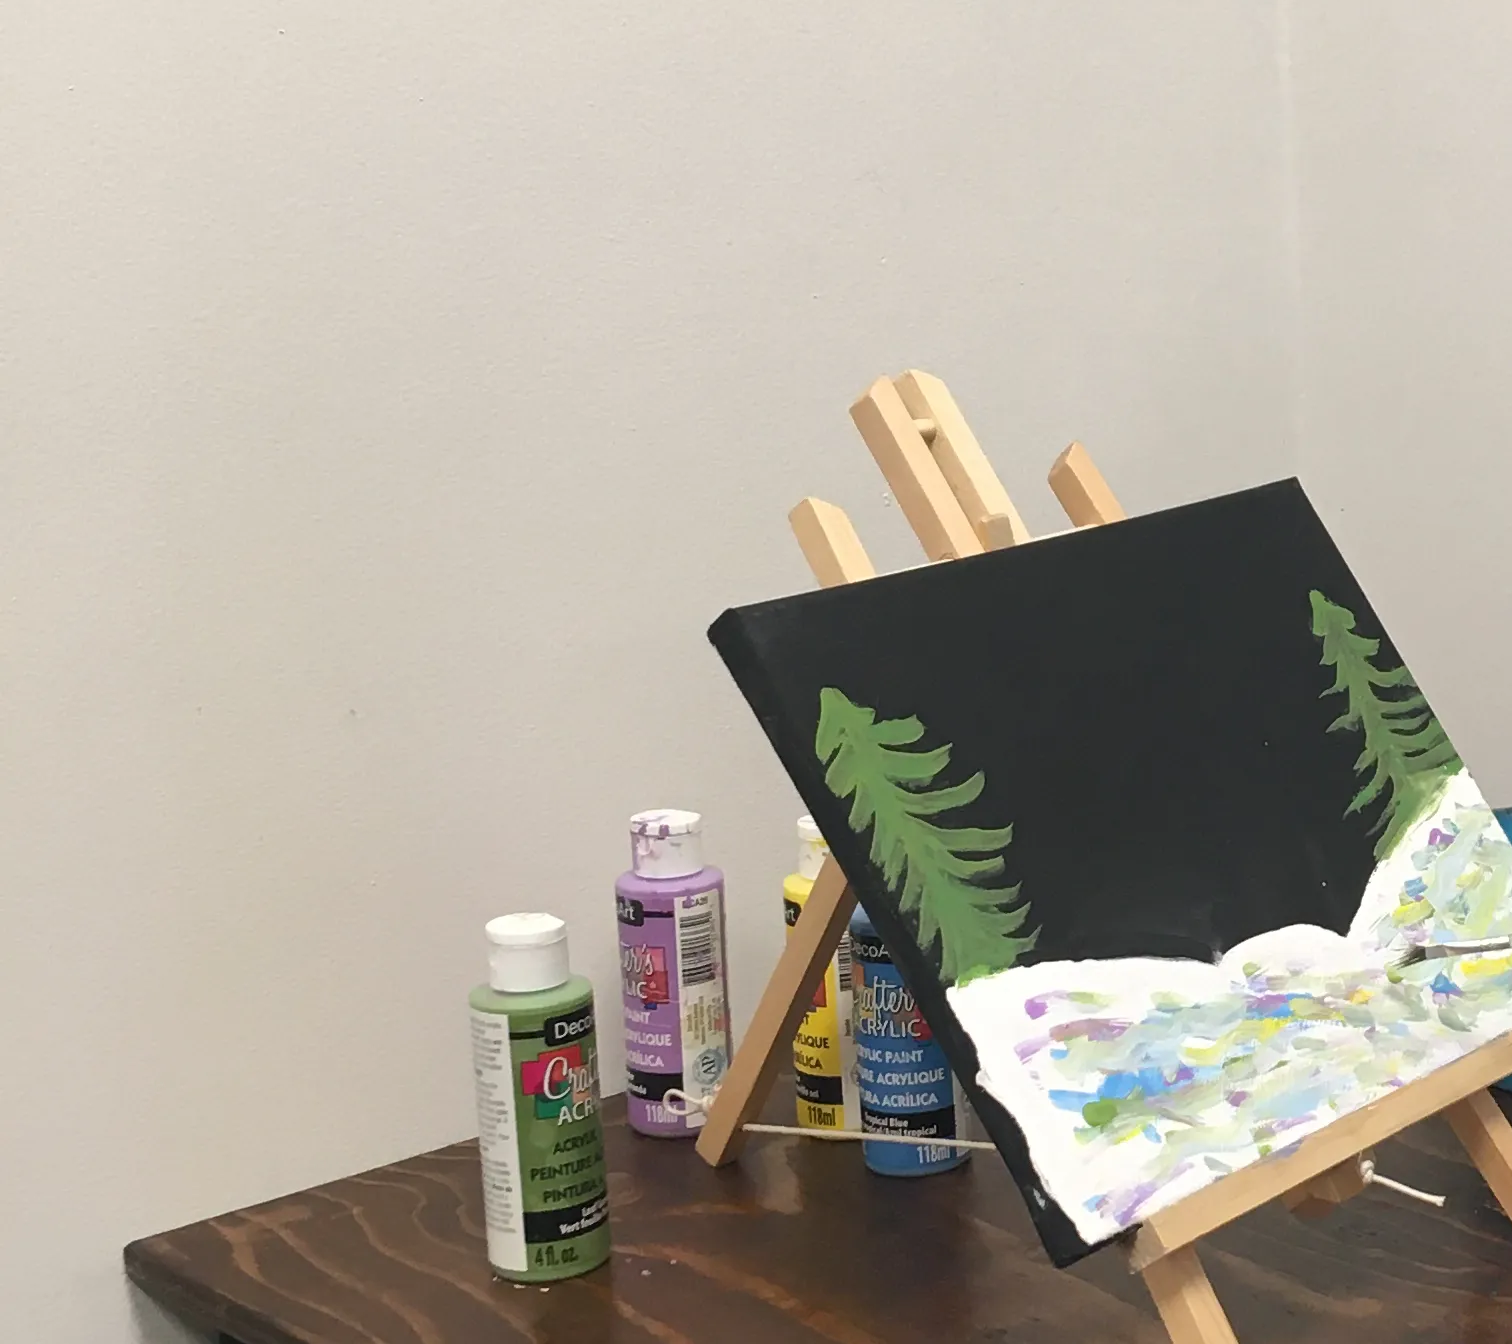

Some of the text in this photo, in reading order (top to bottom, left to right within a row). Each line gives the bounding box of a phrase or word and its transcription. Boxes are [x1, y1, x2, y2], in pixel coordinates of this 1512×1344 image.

[885, 1050, 924, 1064] PAINT
[877, 1068, 945, 1086] ACRYLIQUE
[882, 1092, 938, 1107] ACRÍLICA
[807, 1106, 836, 1126] 118ml
